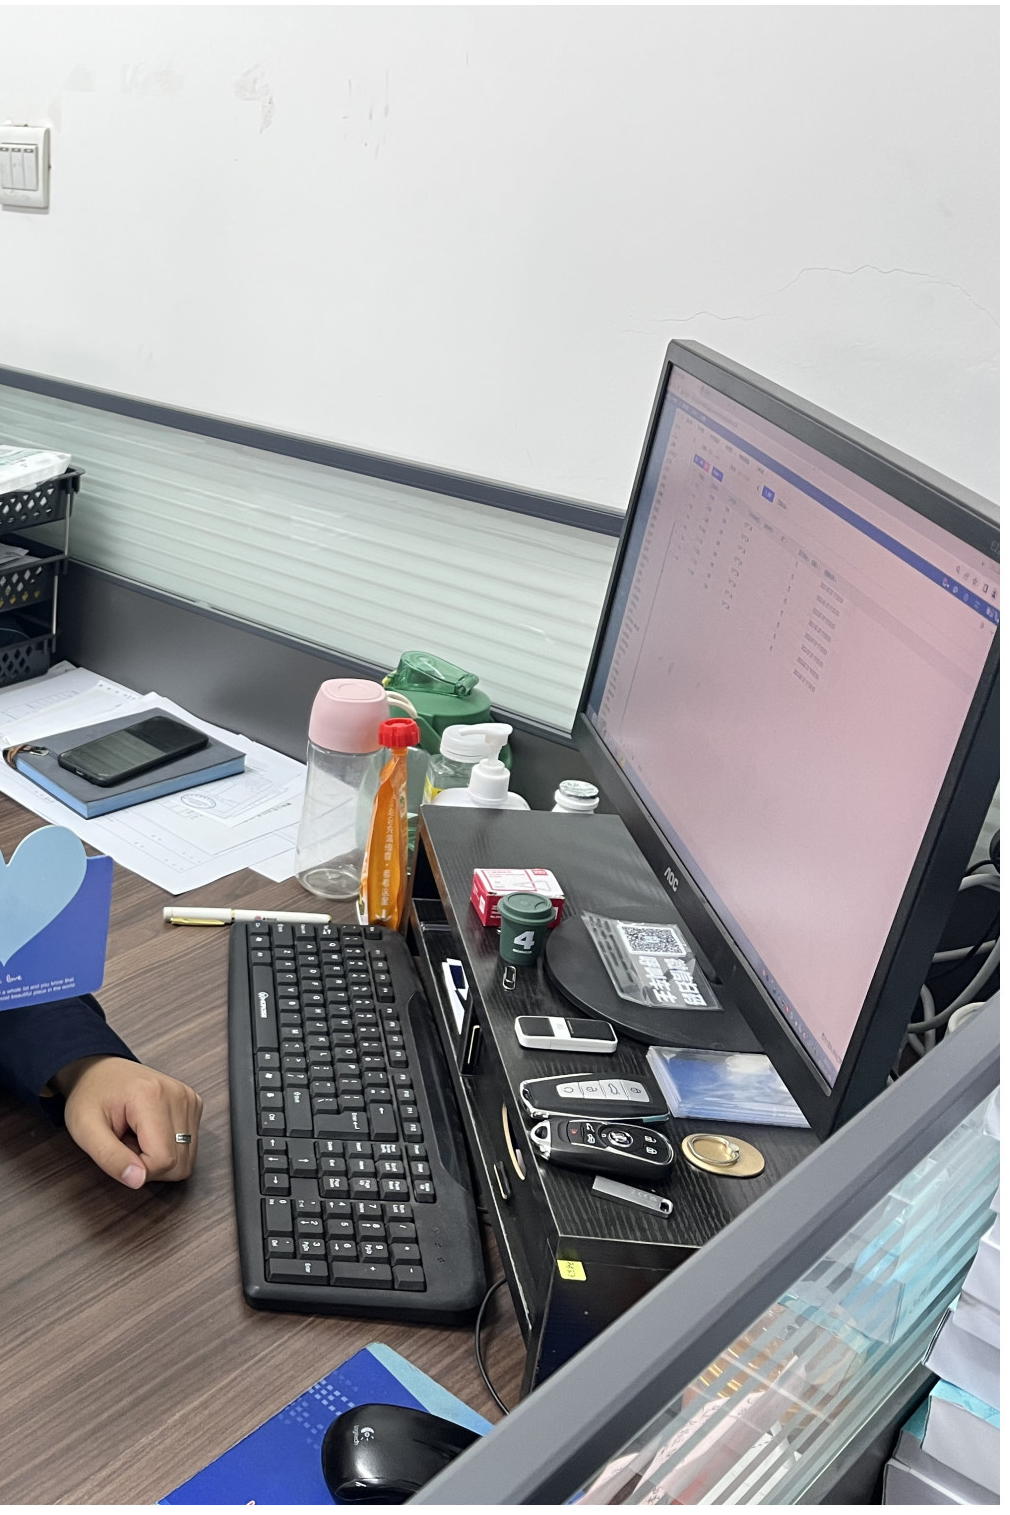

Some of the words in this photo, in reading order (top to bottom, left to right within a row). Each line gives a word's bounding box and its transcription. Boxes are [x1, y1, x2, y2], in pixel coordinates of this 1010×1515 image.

[664, 867, 679, 891] AOC
[514, 931, 535, 949] 4
[6, 974, 22, 983] love
[639, 956, 677, 1003] 呼叫车主
[664, 958, 708, 1006] 微信扫码
